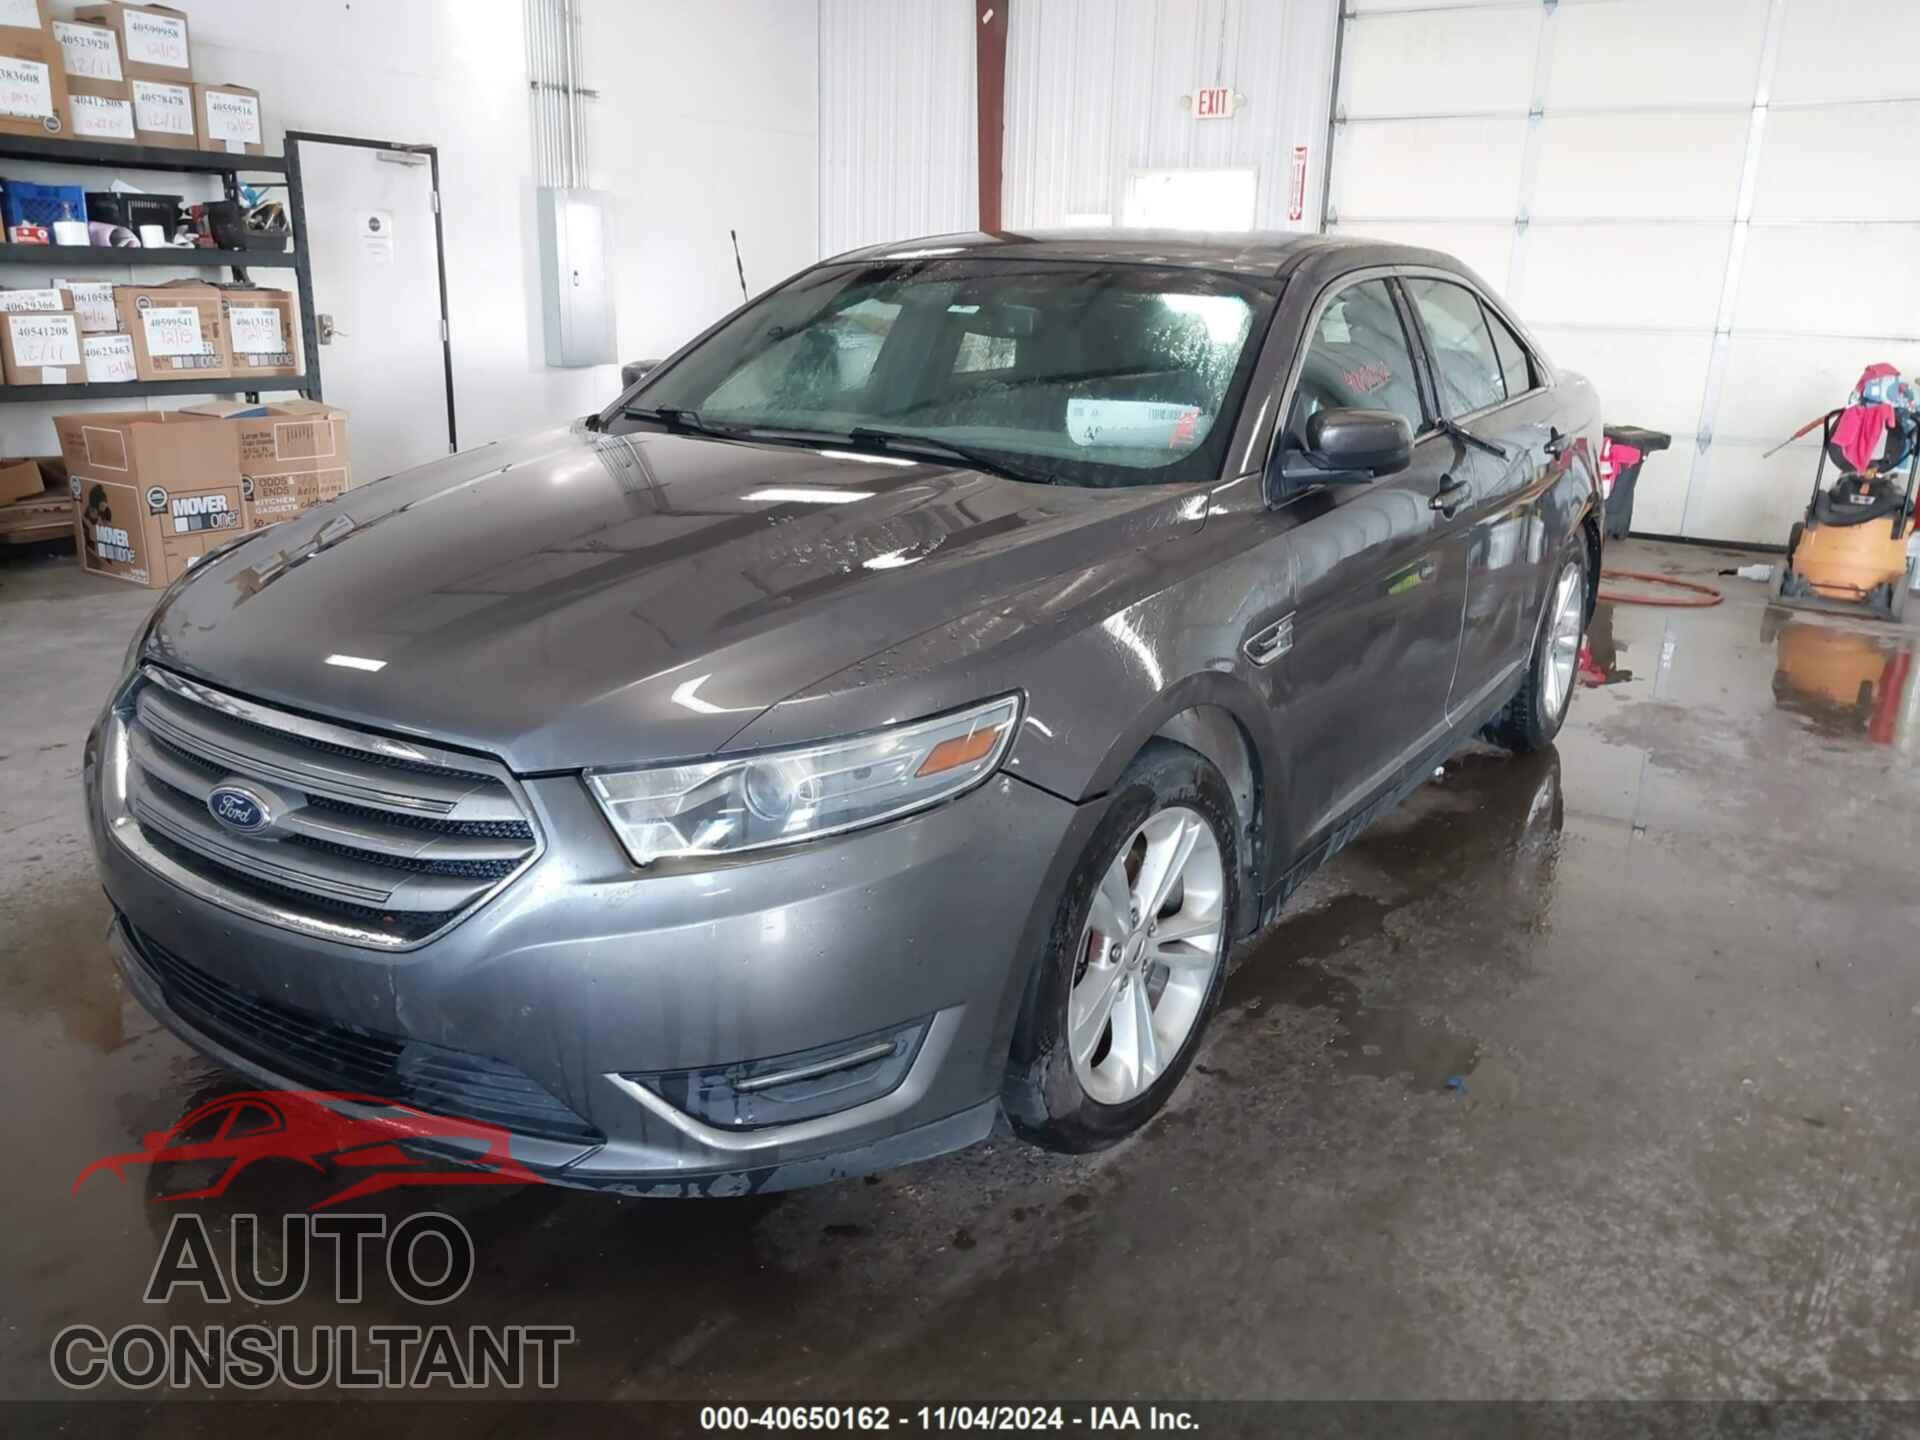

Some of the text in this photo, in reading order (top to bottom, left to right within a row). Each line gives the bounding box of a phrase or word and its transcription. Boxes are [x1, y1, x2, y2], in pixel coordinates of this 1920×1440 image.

[1199, 90, 1228, 115] EXIT
[18, 326, 69, 337] 40541208
[150, 317, 193, 328] 40599541
[258, 478, 287, 488] ODDS
[262, 486, 289, 497] ENDS
[172, 495, 227, 516] MOVER
[210, 511, 236, 529] one
[96, 525, 129, 548] MOVER
[218, 795, 252, 823] Ford
